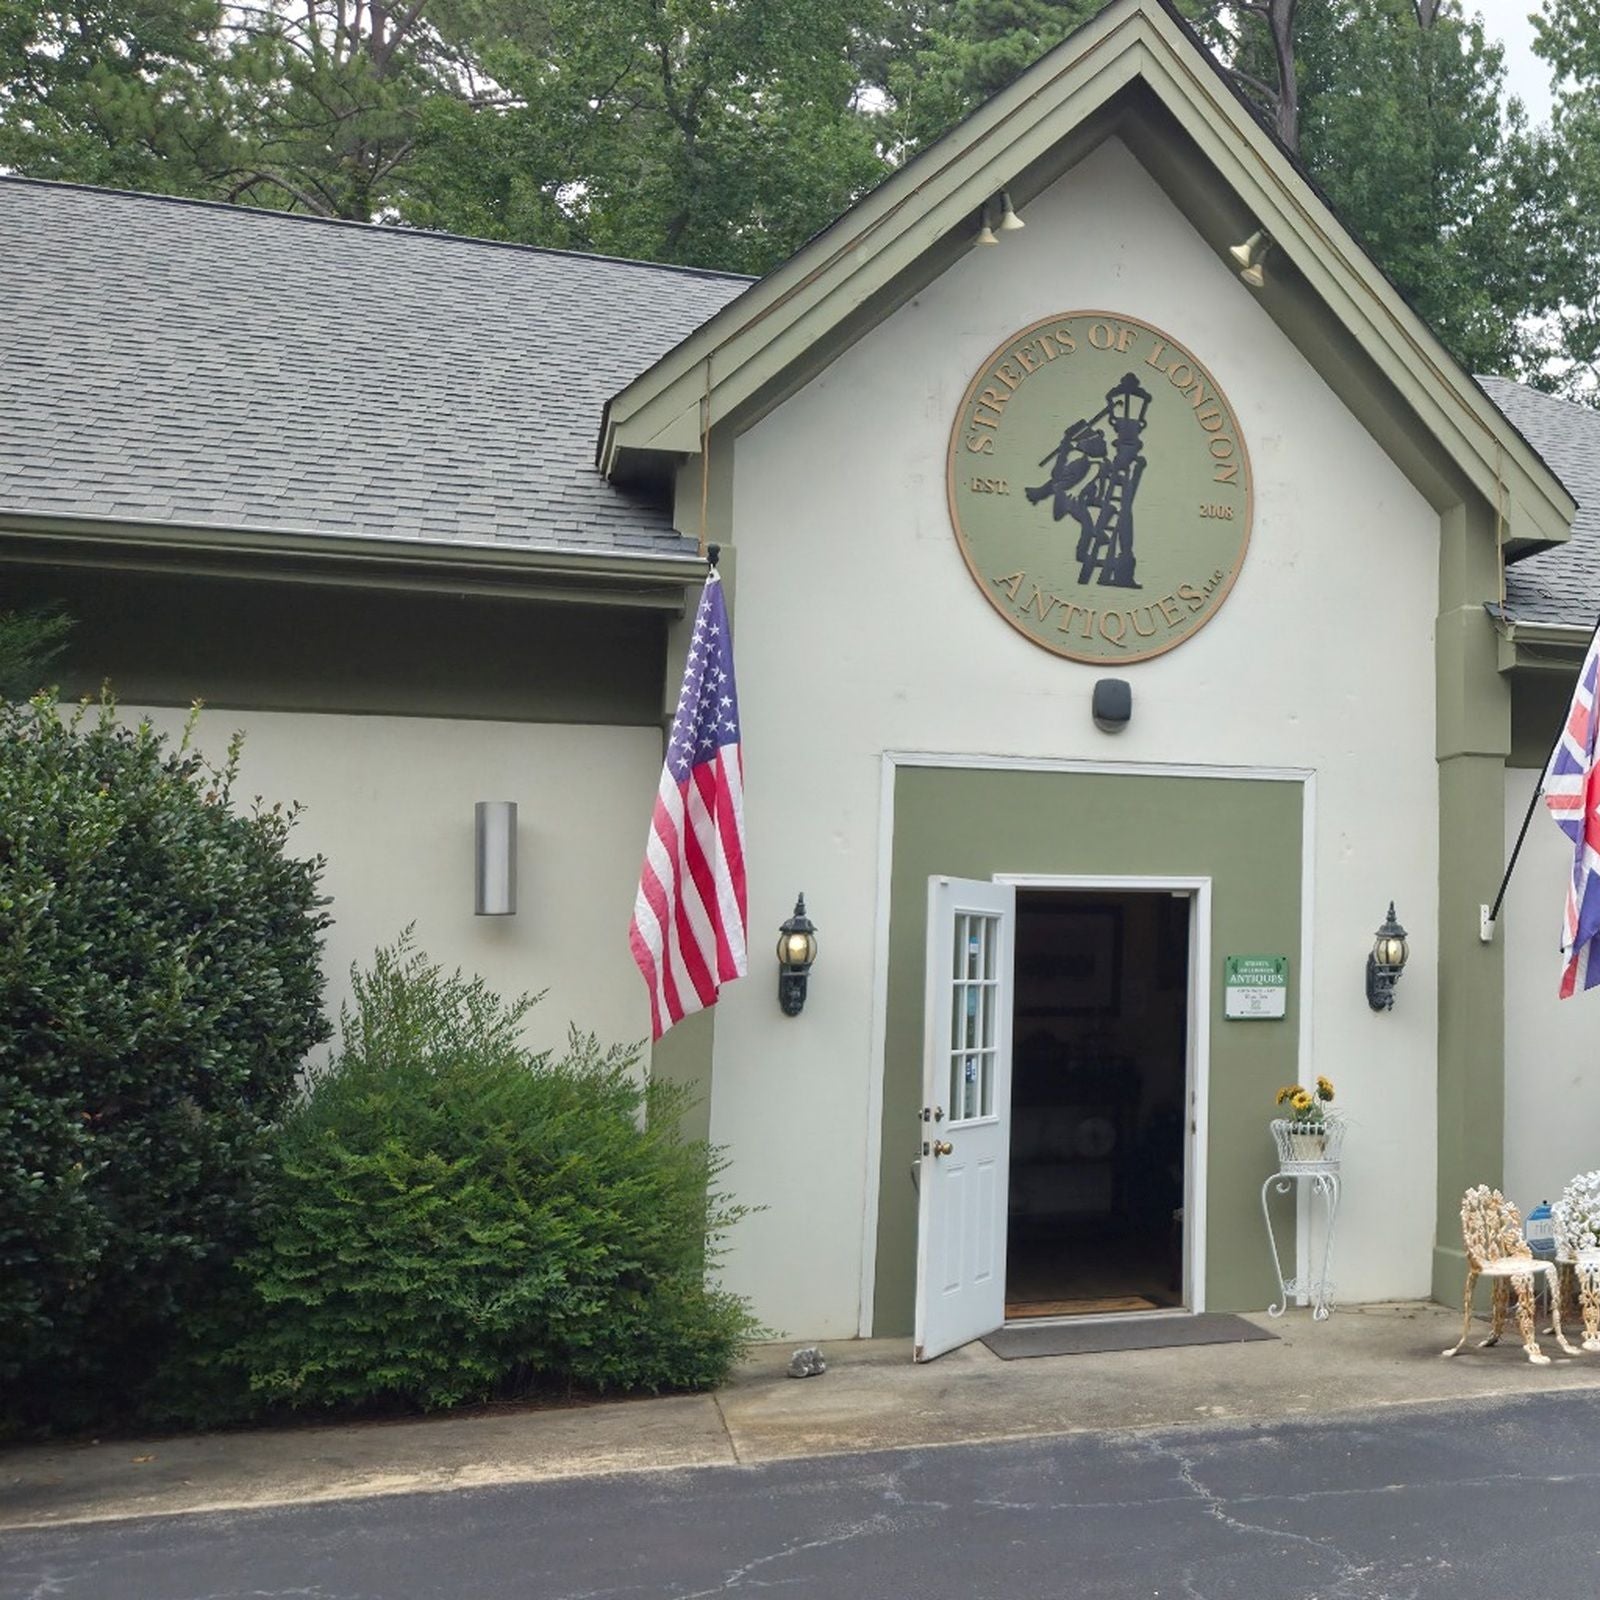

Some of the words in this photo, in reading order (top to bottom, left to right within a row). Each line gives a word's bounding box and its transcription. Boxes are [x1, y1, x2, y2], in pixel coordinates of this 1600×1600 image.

[965, 328, 1077, 456] STREETS
[1088, 323, 1139, 354] OF
[1145, 343, 1239, 487] LONDON
[970, 477, 1011, 496] EST.
[1199, 504, 1234, 520] 2008
[1229, 974, 1284, 985] ANTIQUES
